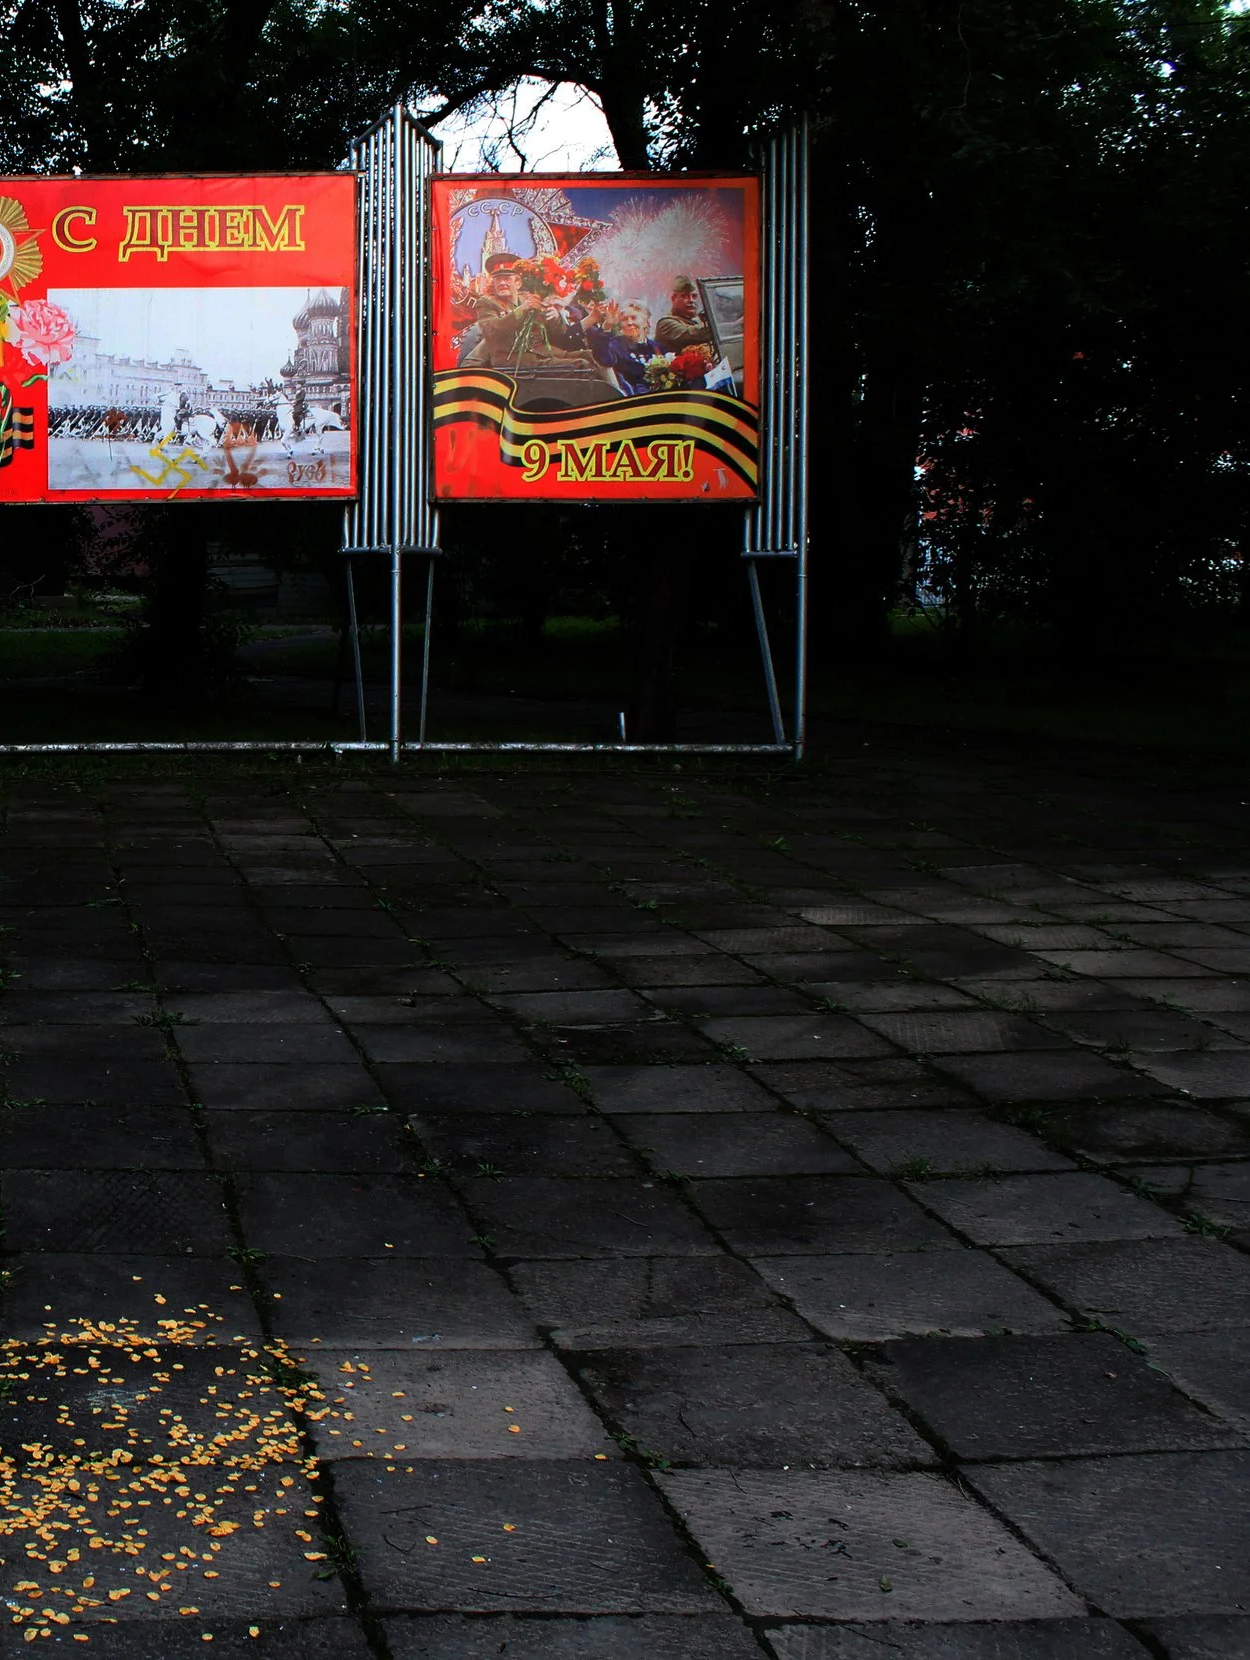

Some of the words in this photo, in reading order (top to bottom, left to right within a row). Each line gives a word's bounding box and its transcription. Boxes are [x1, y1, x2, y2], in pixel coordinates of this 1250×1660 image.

[468, 201, 524, 217] СССР
[52, 206, 97, 253] С
[118, 205, 305, 262] ДНЕМ
[521, 439, 550, 482] 9
[557, 440, 695, 482] МАЯ!
